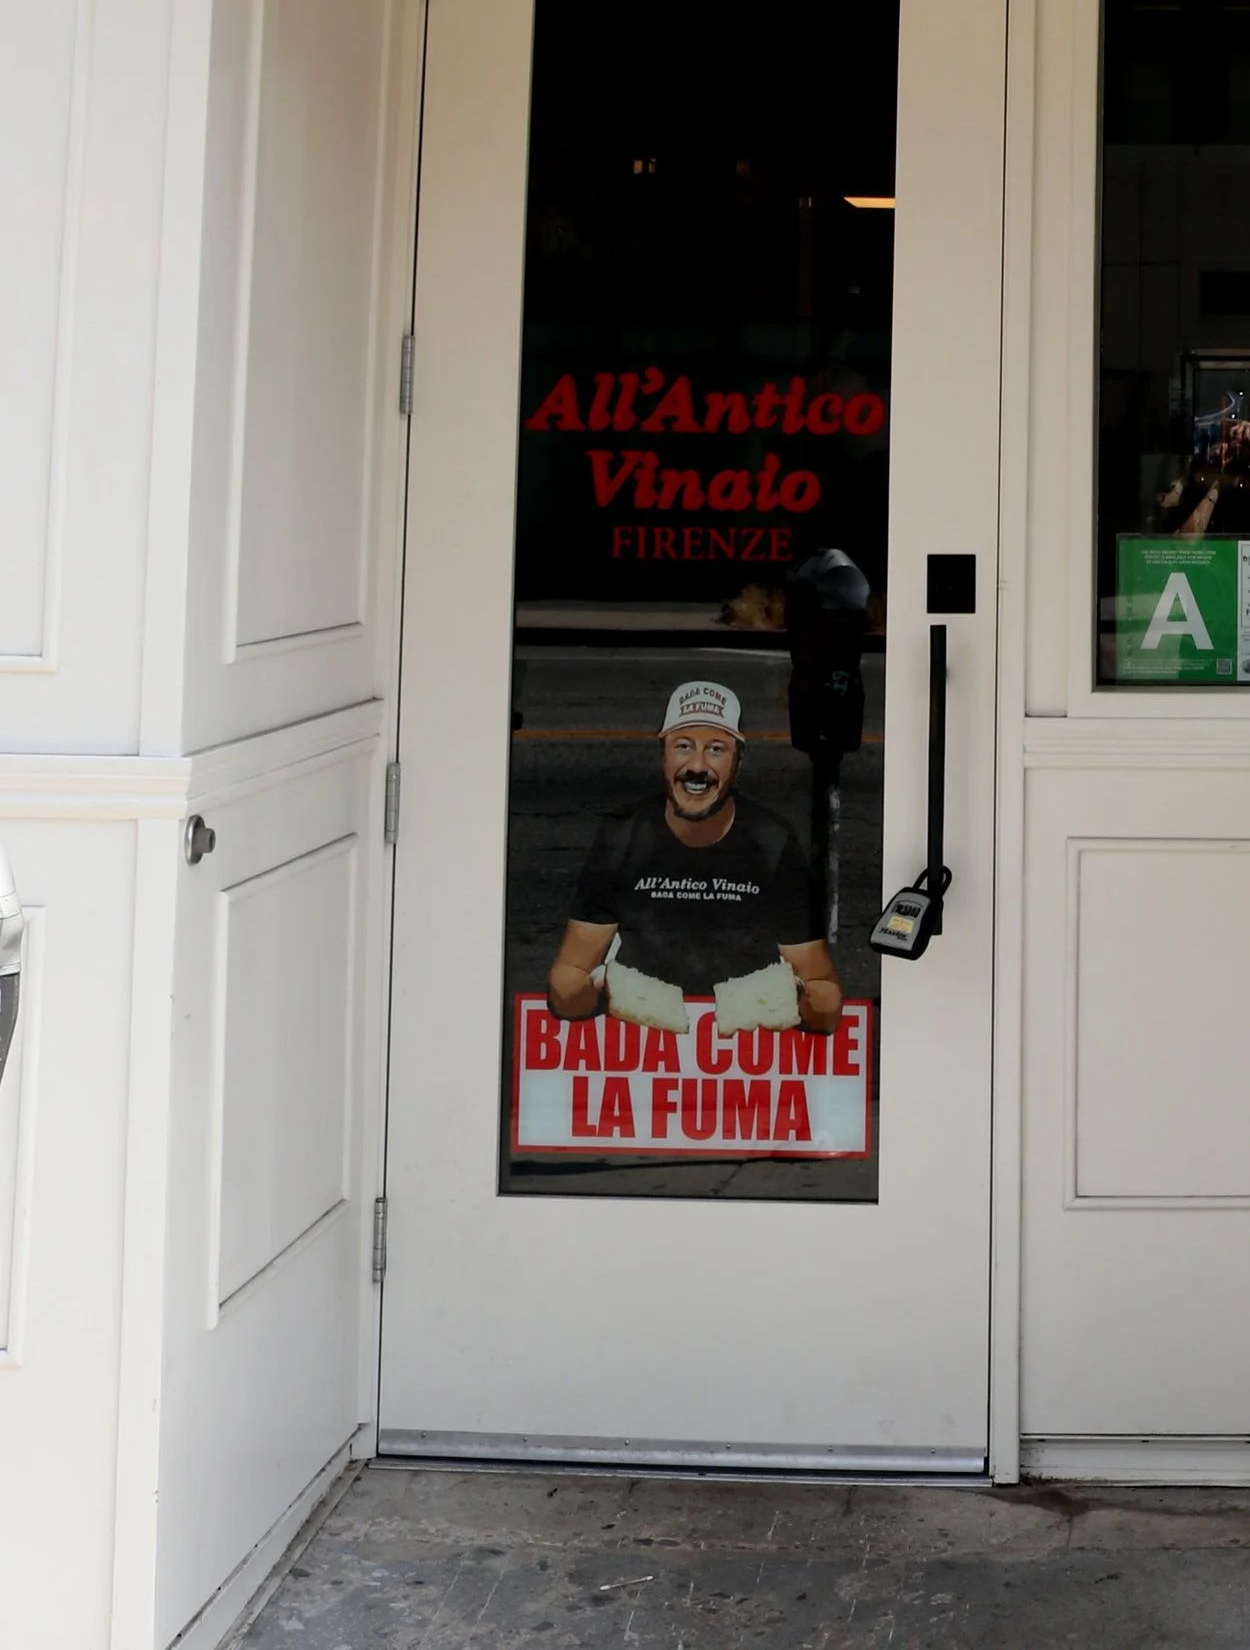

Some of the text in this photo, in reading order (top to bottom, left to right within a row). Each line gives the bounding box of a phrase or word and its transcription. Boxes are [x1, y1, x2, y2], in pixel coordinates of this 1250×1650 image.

[525, 366, 886, 435] All'Antico
[586, 450, 821, 512] Vinaio
[610, 526, 792, 561] FIRENZE
[1140, 572, 1214, 650] A
[634, 877, 760, 894] All'Antico Vinaio
[651, 891, 742, 901] BADA COME LA FUMA
[525, 1009, 860, 1076] BADA COME
[571, 1075, 812, 1142] LA FUMA
